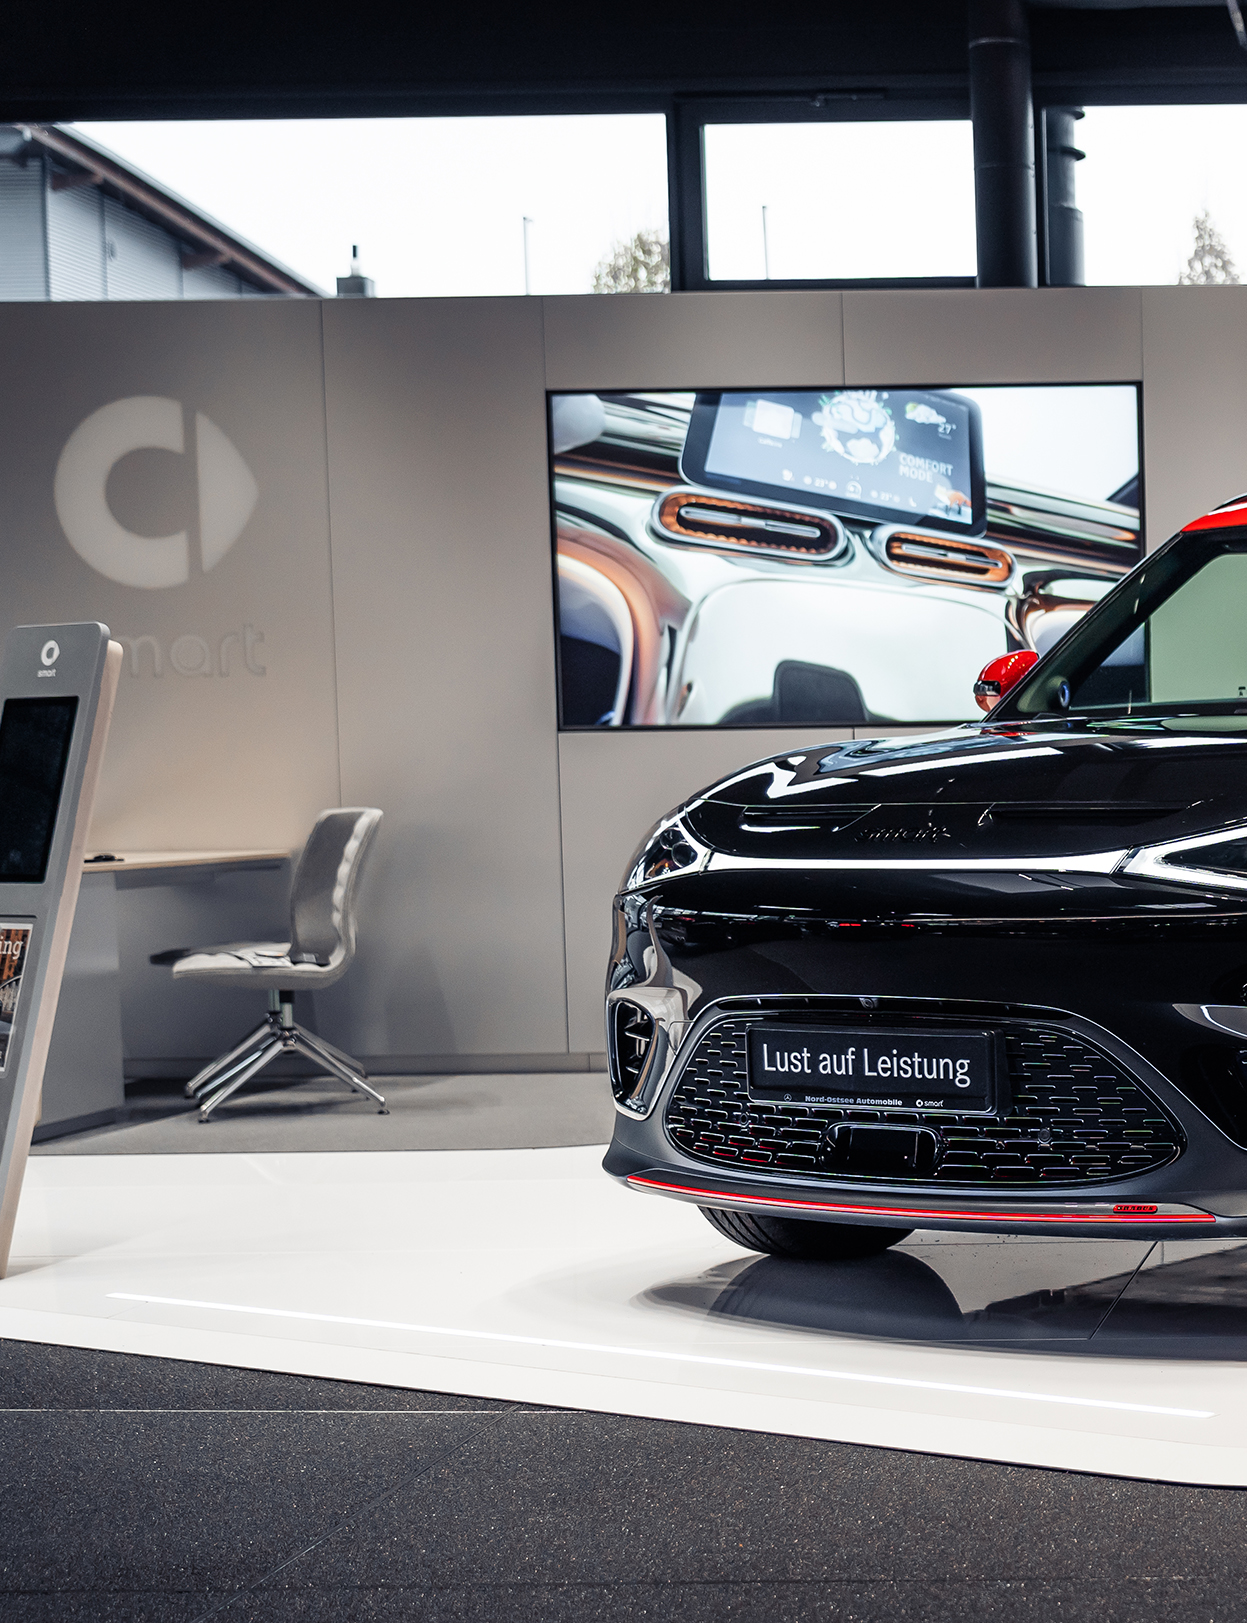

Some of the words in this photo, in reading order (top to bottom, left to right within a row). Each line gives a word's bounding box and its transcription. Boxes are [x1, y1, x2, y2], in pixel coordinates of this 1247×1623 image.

[899, 452, 954, 477] COMFORT
[899, 465, 934, 484] MODE
[116, 624, 267, 678] mart
[763, 1043, 812, 1074] Lust
[819, 1047, 856, 1076] auf
[863, 1048, 972, 1089] Leistung
[805, 1095, 854, 1105] Nord-Ostsee
[856, 1097, 903, 1106] Automobile
[924, 1099, 944, 1107] smart
